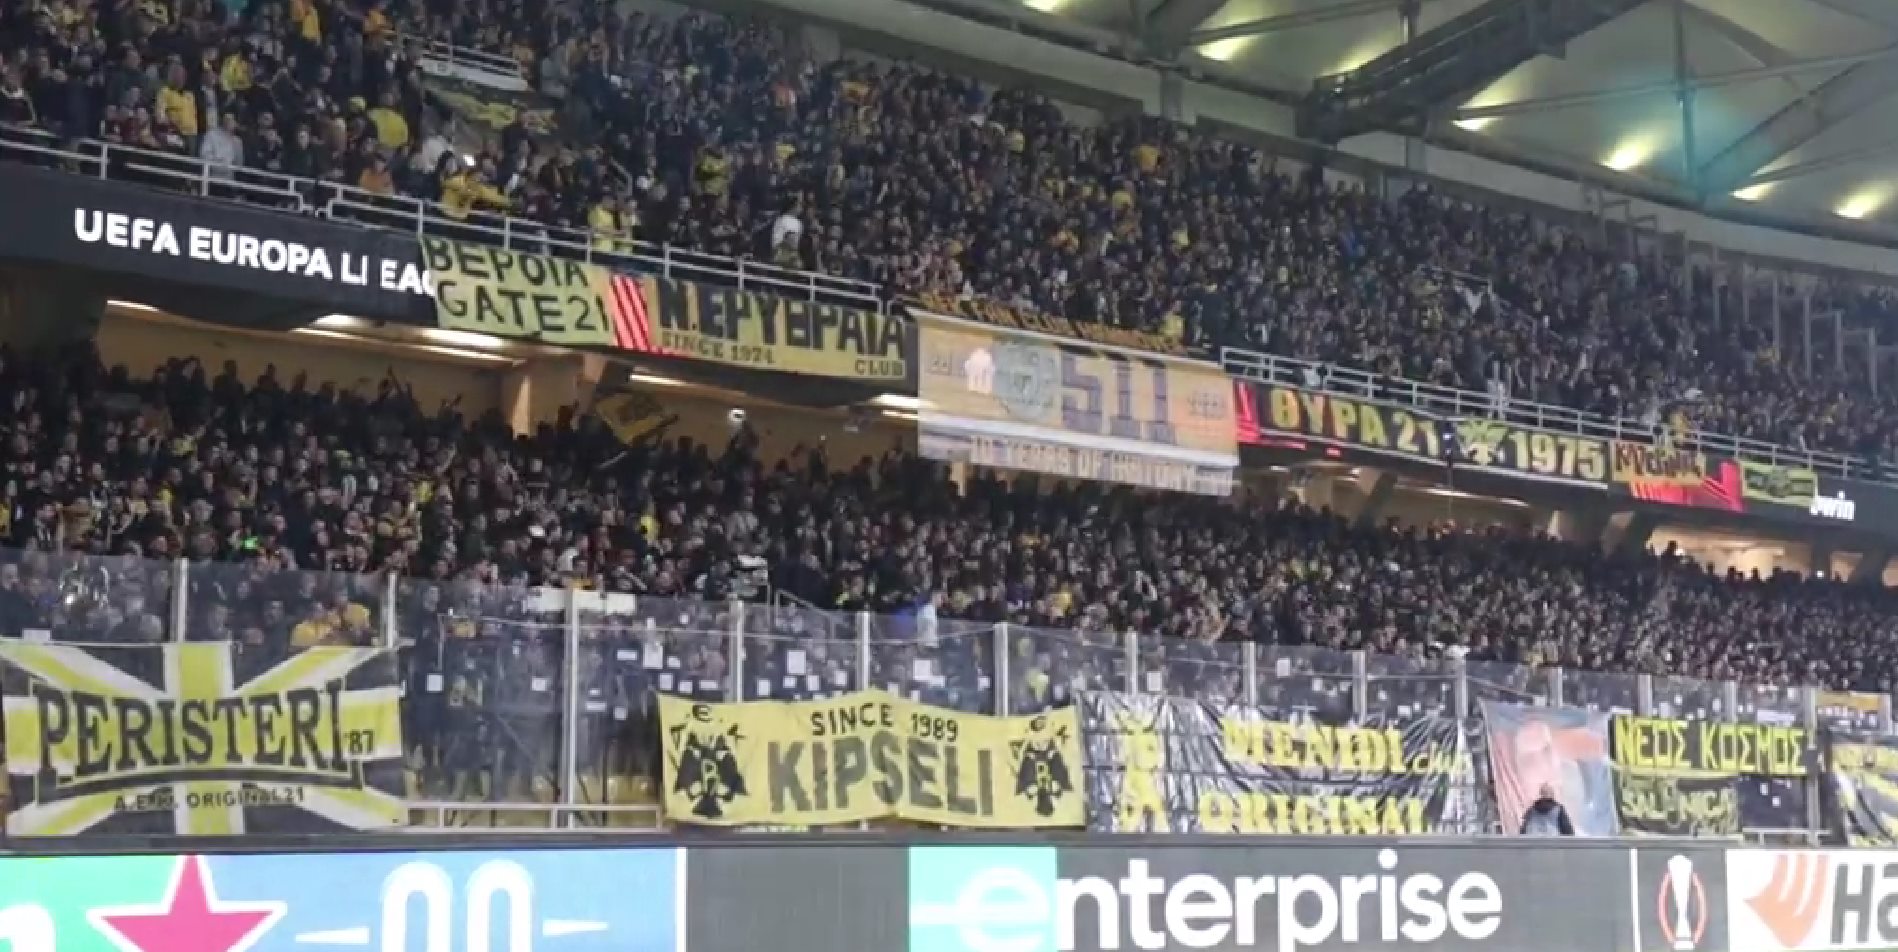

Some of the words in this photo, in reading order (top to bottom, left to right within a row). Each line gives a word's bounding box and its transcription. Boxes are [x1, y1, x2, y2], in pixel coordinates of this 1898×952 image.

[74, 208, 181, 256] UEFA
[189, 225, 333, 280] EUROPA
[854, 358, 904, 376] CLUB
[1392, 410, 1440, 456] 21
[1509, 430, 1606, 481] 1975
[33, 677, 352, 780] PERISTERI
[811, 702, 893, 737] SINCE
[911, 712, 959, 742] 1989
[1614, 712, 1692, 772] ΝΕΟΣ
[1698, 719, 1809, 776] ΚΟΣΜΟΣ
[766, 730, 994, 817] KIPSELI
[954, 848, 1503, 952] enterprise
